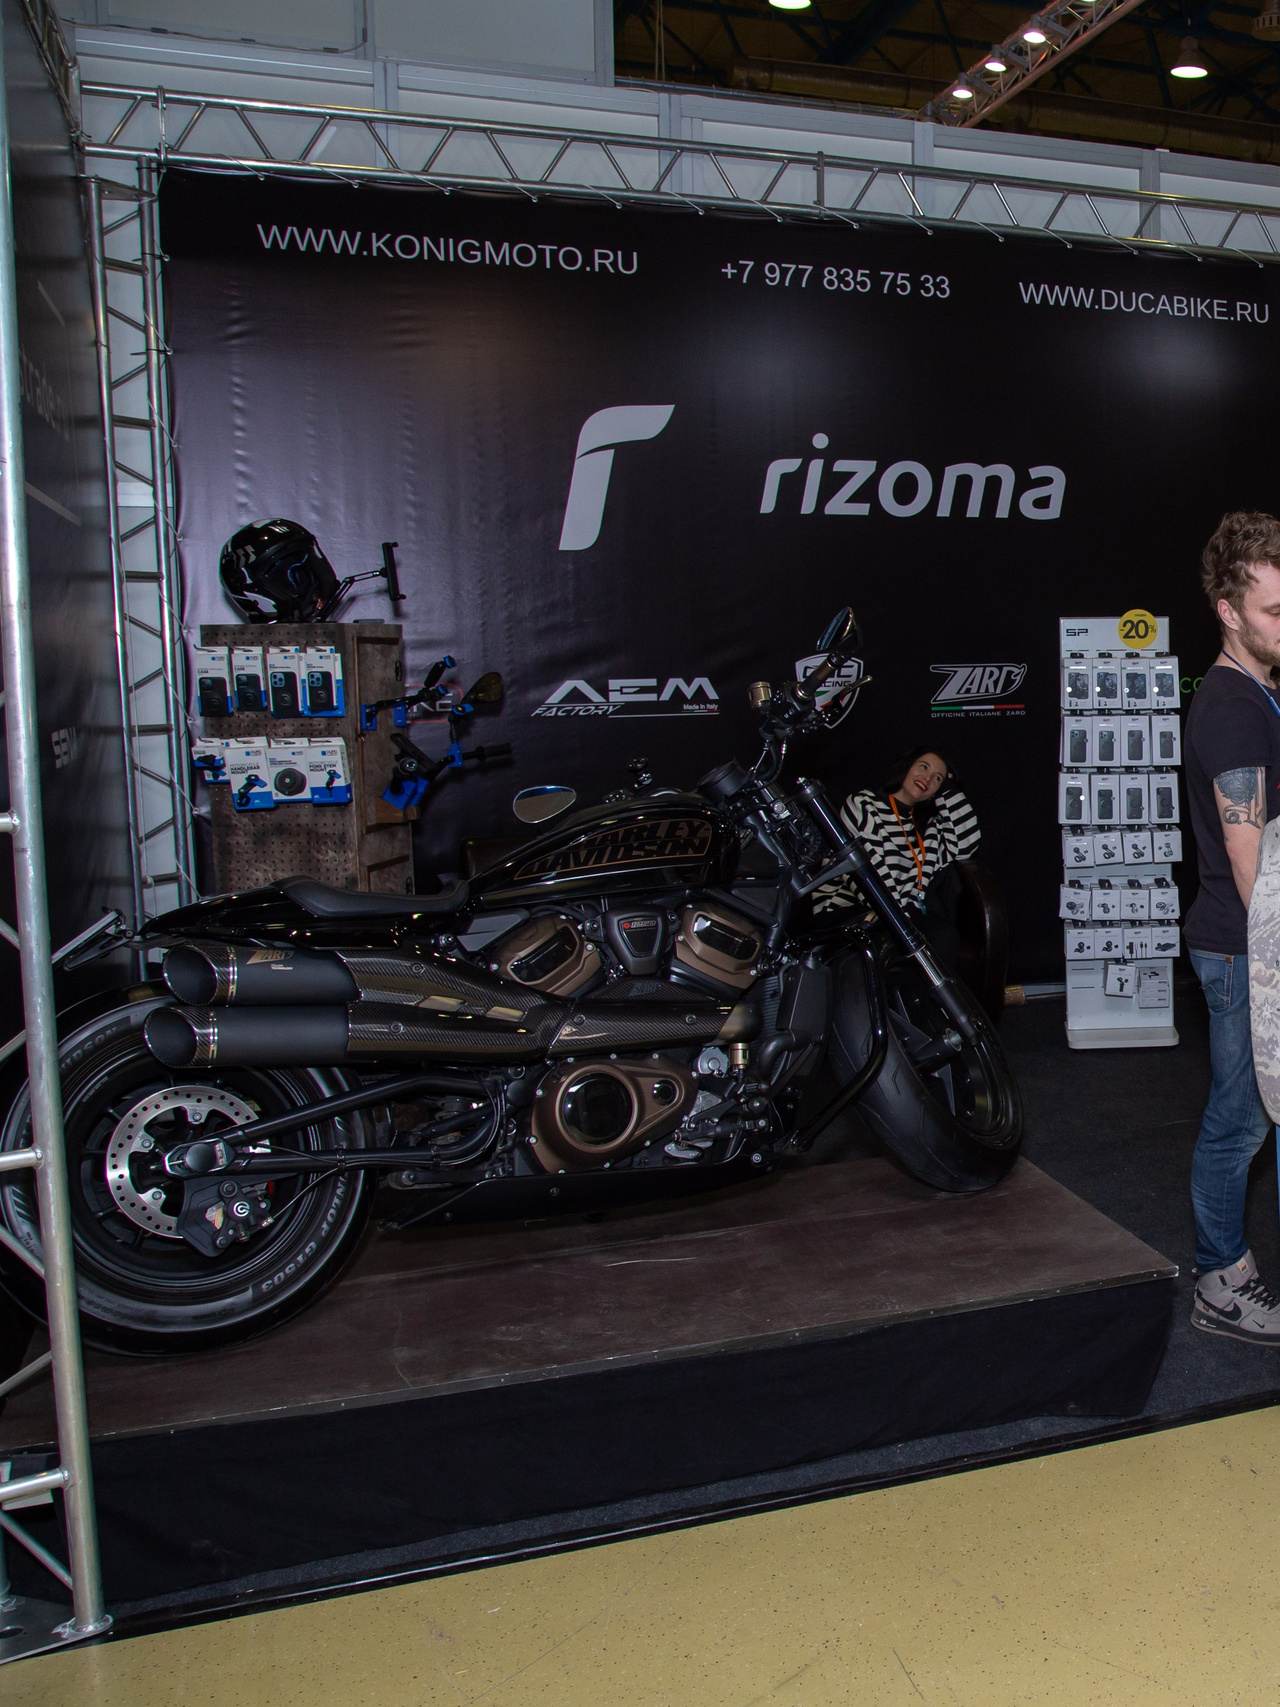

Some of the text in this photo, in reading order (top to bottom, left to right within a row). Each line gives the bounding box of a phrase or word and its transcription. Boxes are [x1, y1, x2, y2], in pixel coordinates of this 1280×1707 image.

[256, 223, 638, 275] WWW.KONIGMOTO.RU
[721, 260, 951, 299] +7 977 835 75 33
[1018, 281, 1270, 324] WWW.DUCABIKE.RU
[760, 432, 1066, 520] rizoma
[531, 704, 622, 717] FACTORY
